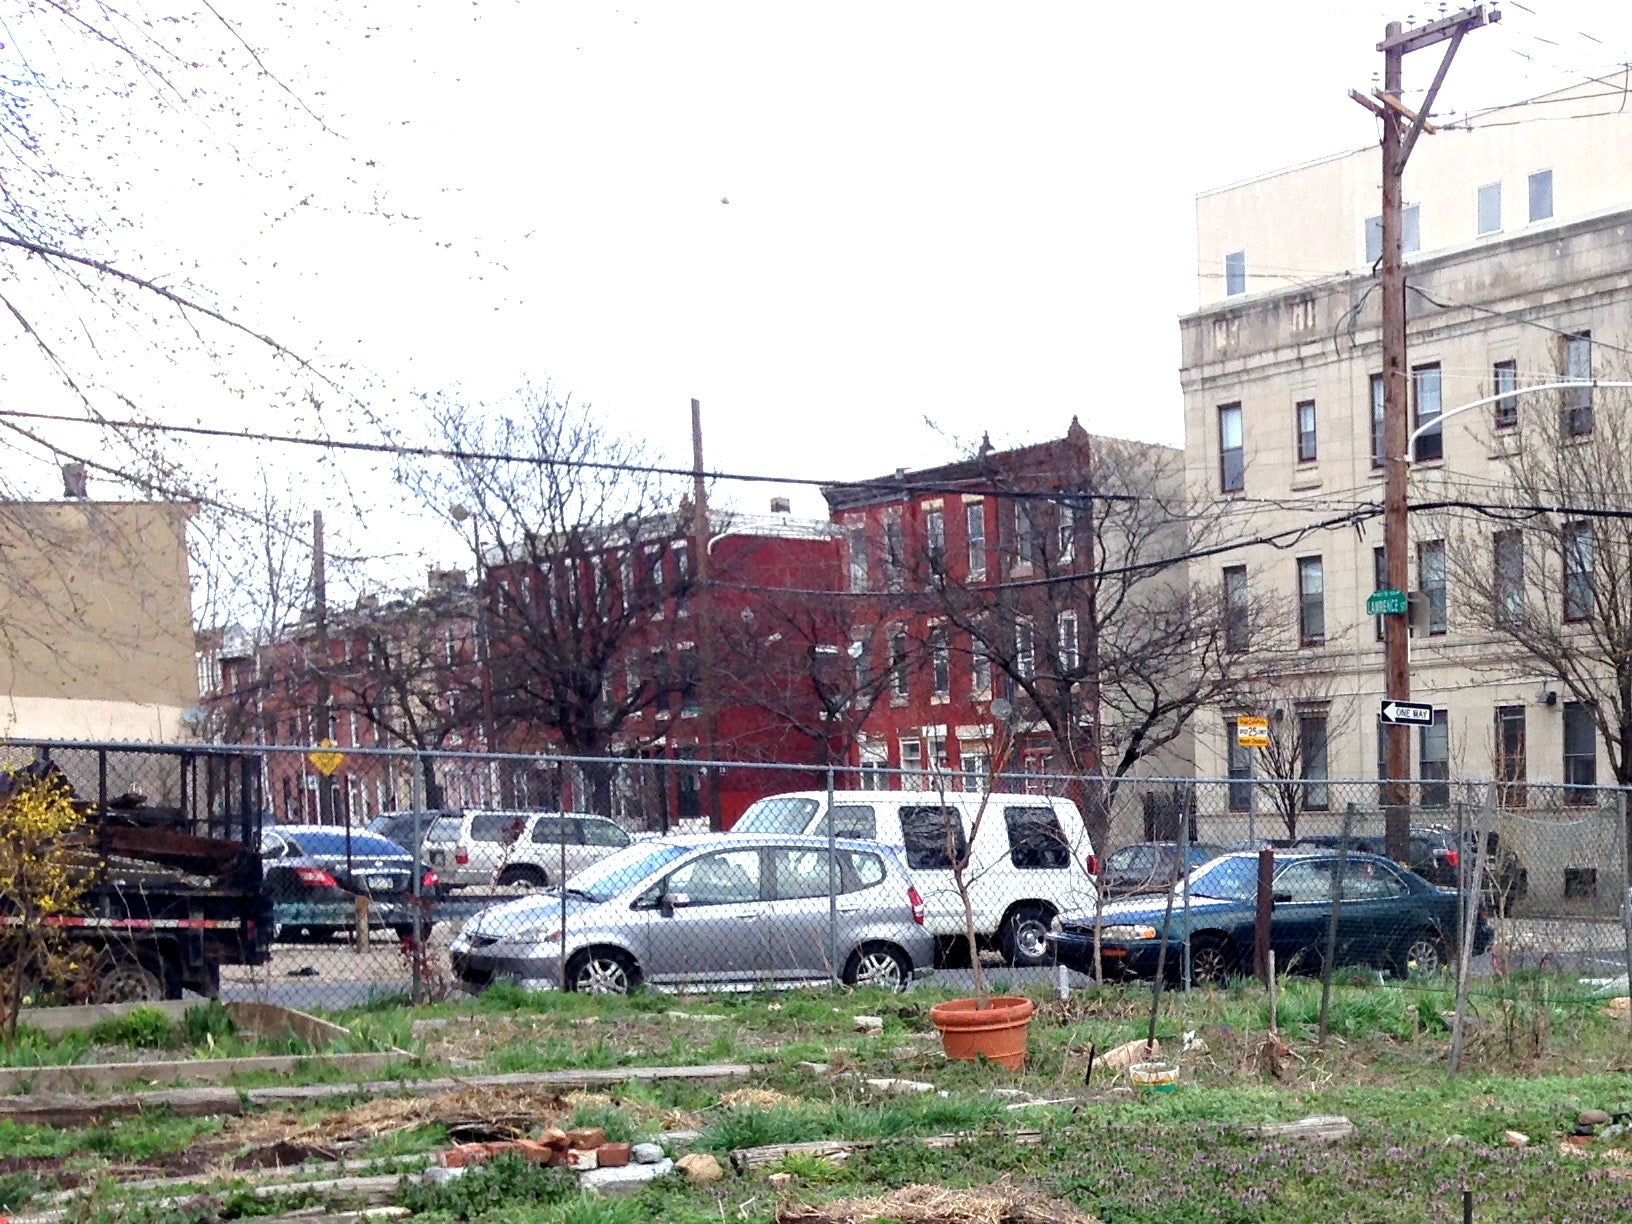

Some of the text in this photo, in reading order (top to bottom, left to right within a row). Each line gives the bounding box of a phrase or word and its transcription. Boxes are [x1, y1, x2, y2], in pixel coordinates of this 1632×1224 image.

[1396, 707, 1428, 719] ONE WAY
[1248, 727, 1257, 737] 25
